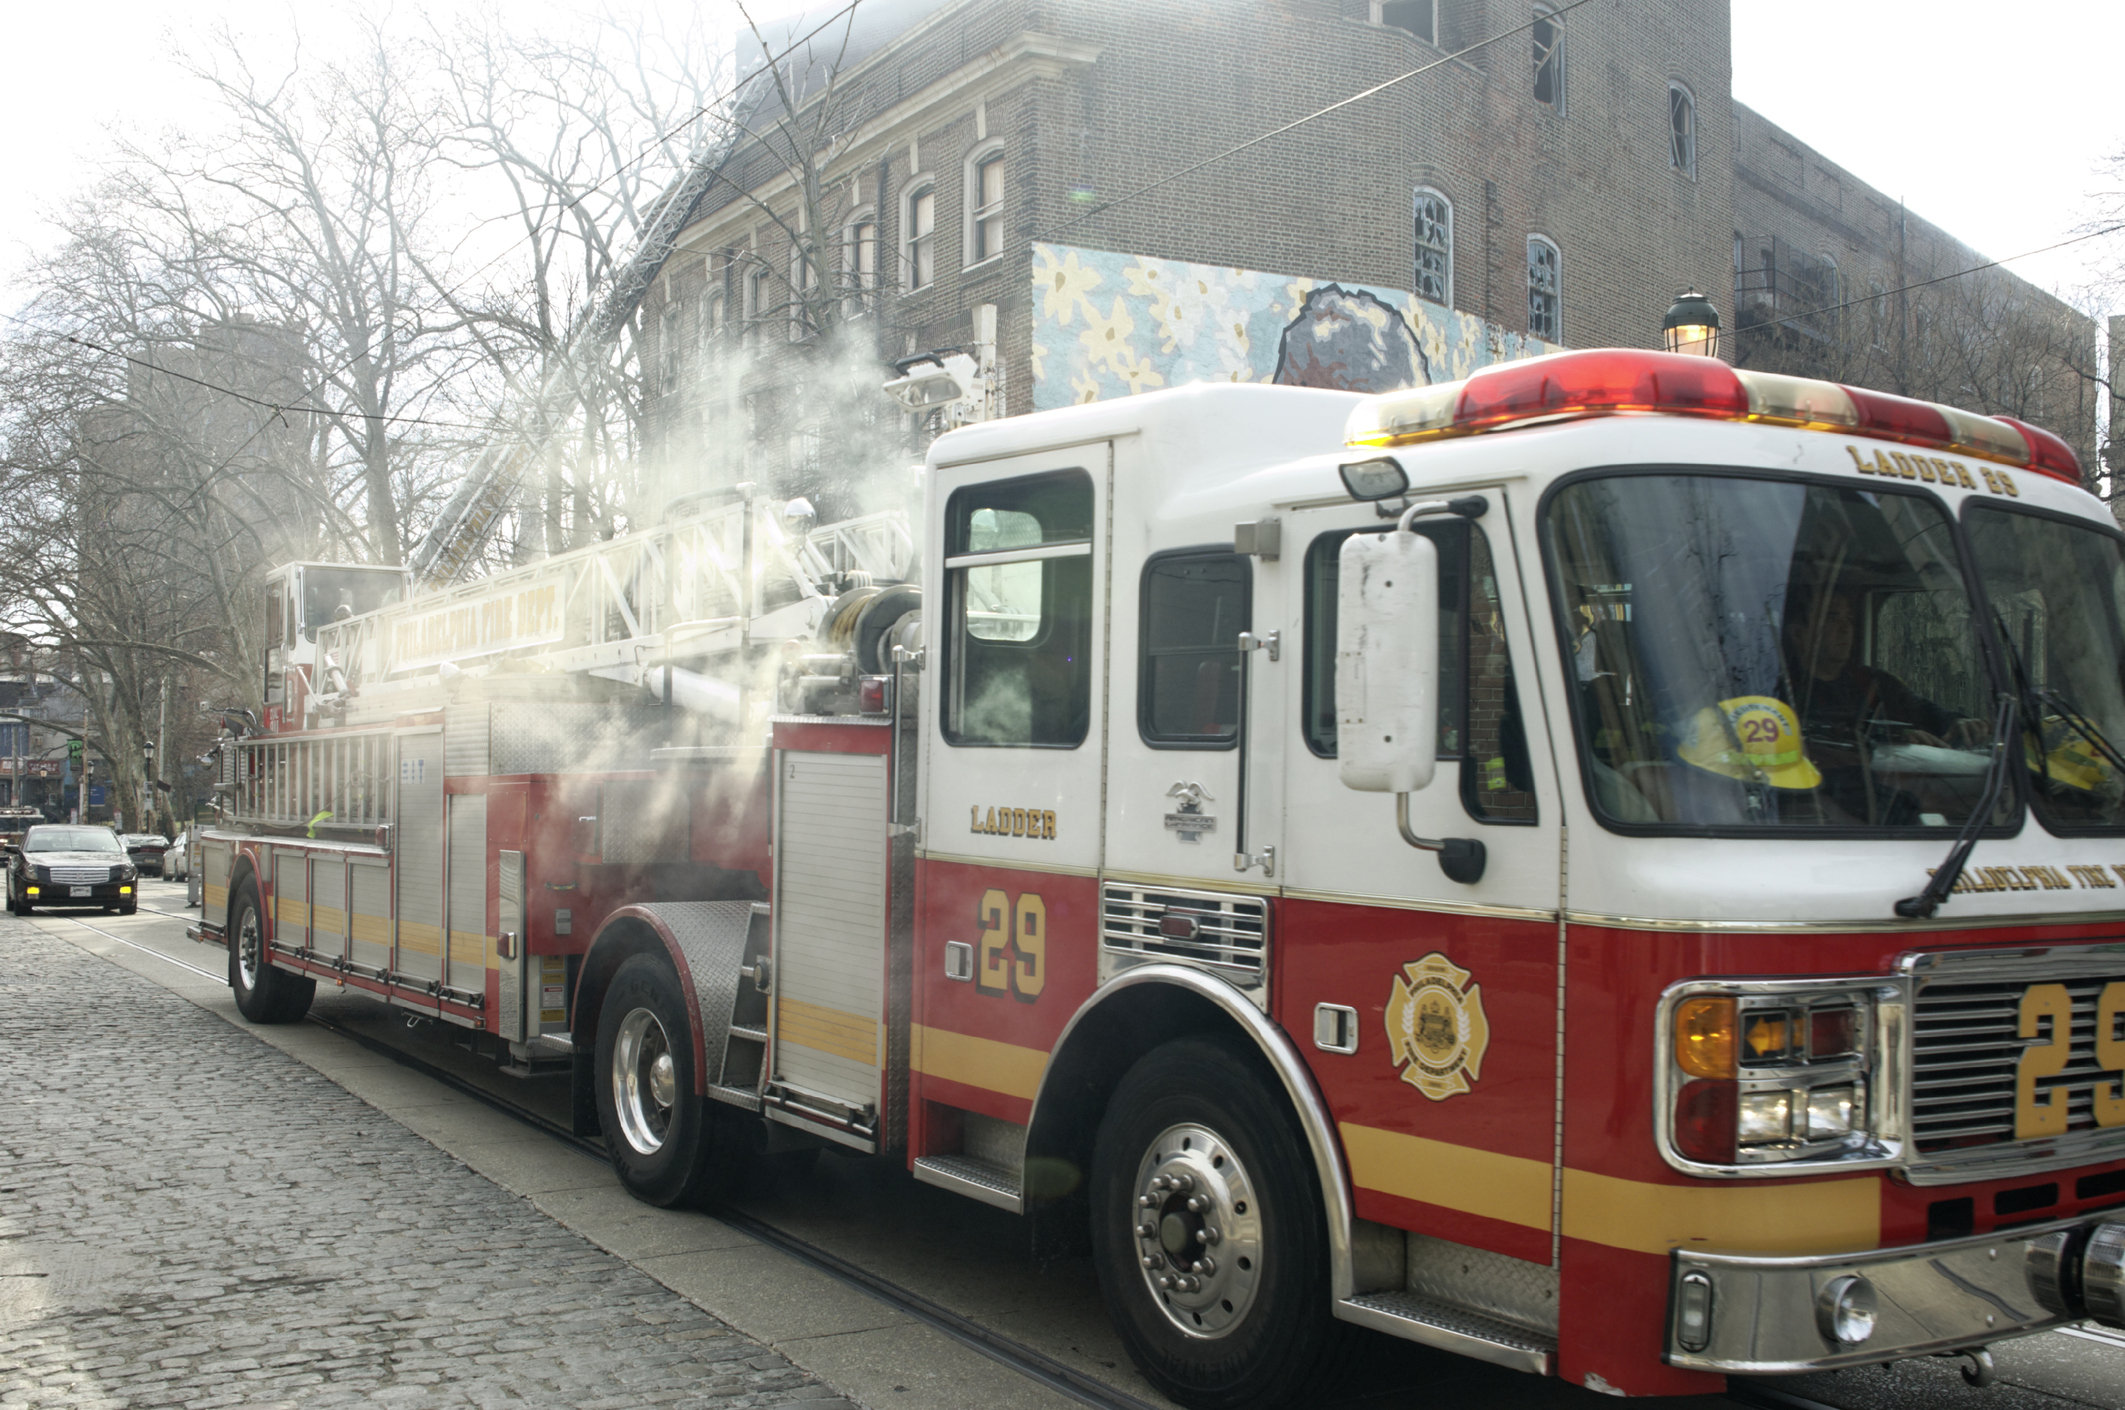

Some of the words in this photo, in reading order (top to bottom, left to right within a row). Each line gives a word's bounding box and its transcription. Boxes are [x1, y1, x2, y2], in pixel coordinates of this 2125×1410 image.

[1845, 445, 1977, 490] LADDER
[1980, 466, 2018, 497] 29
[396, 605, 477, 662] PHILADELPHIA
[482, 596, 512, 644] FIRE
[517, 585, 558, 637] DEPT.
[1744, 718, 1778, 743] 29
[789, 764, 796, 779] 2
[971, 805, 1057, 840] LADDER
[1926, 867, 2072, 894] ILADELPHIA
[2066, 864, 2116, 889] FIRE
[977, 888, 1046, 1001] 29
[2014, 976, 2125, 1140] 29
